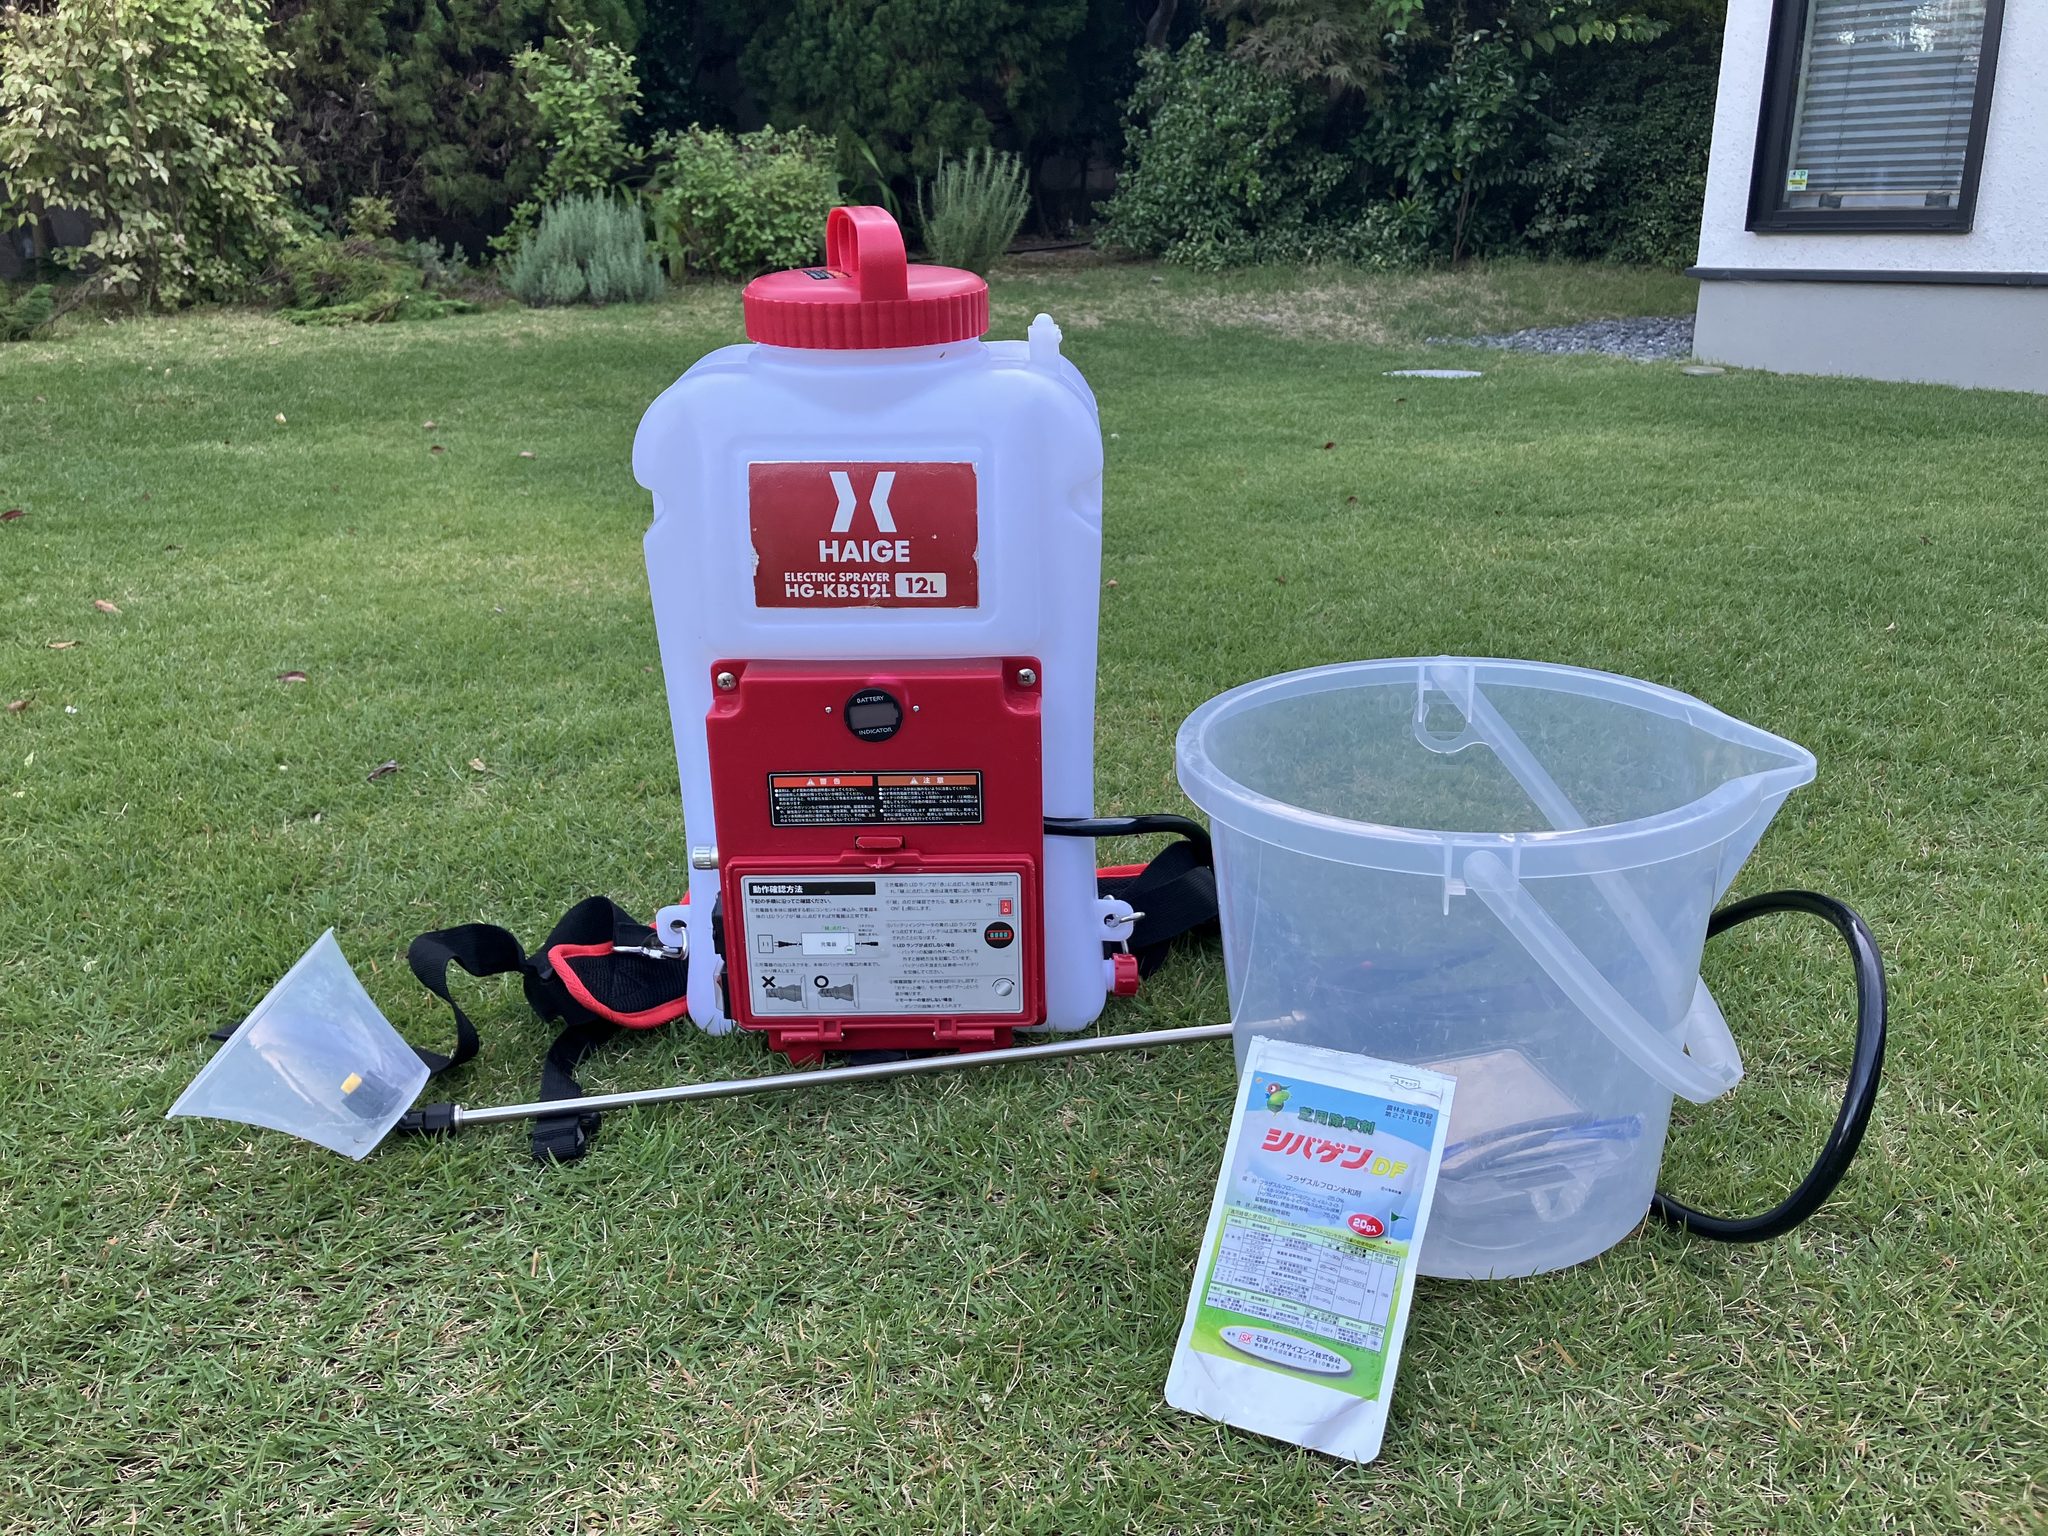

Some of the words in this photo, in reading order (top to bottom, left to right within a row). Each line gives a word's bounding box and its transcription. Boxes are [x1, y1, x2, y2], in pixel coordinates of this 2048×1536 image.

[819, 539, 910, 563] HAIGE
[784, 572, 836, 582] ELECTRIC
[839, 572, 890, 582] SPRAYER
[785, 583, 891, 598] HG-KBS12L
[905, 577, 937, 594] 12L
[856, 695, 884, 704] BATTERY
[858, 727, 893, 736] INDICATOR
[752, 885, 803, 894] 動作確認方法
[1385, 1104, 1433, 1120] 農林水産省登録
[1297, 1106, 1376, 1136] 芝用除草剤
[1286, 1174, 1362, 1198] フラザスルフロン水和剤
[1353, 1218, 1377, 1233] 20g入
